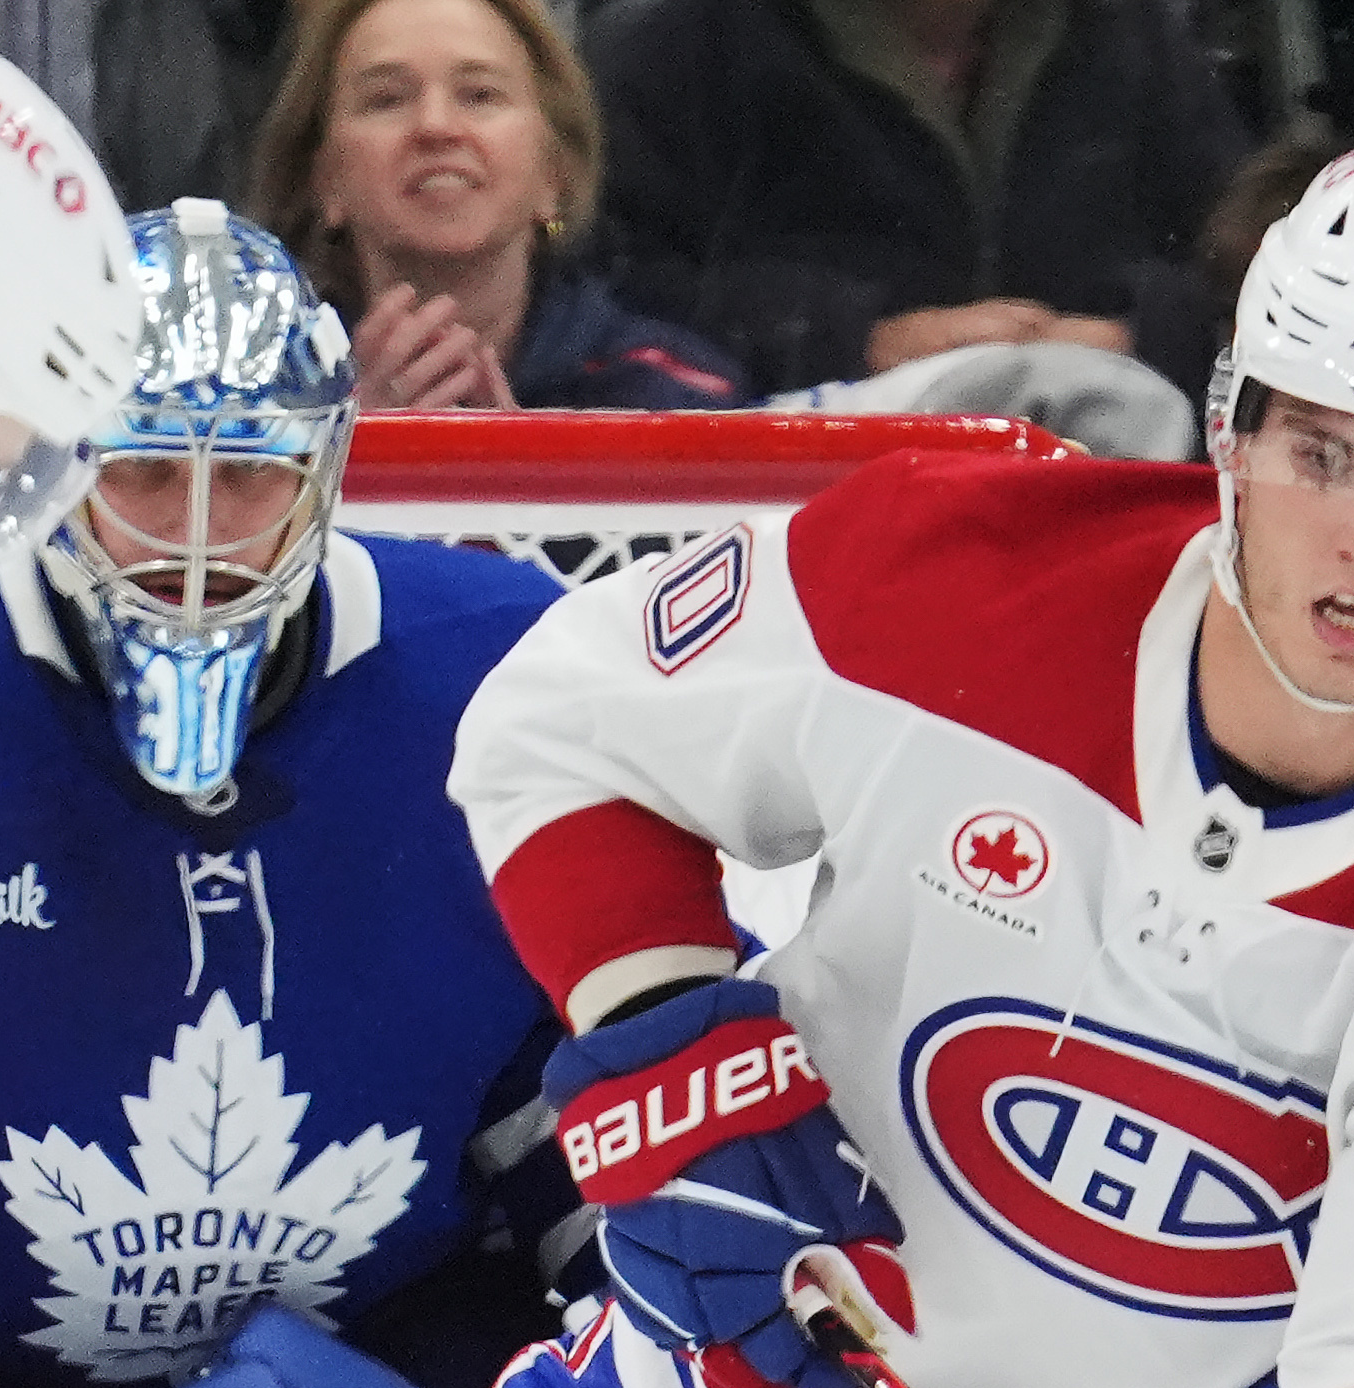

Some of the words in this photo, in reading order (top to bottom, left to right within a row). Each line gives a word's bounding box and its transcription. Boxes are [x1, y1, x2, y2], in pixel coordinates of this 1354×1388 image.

[918, 870, 948, 896] AIR
[953, 892, 1037, 936] CANADA
[72, 1207, 337, 1267] TORONTO
[111, 1260, 289, 1298] MAPLE
